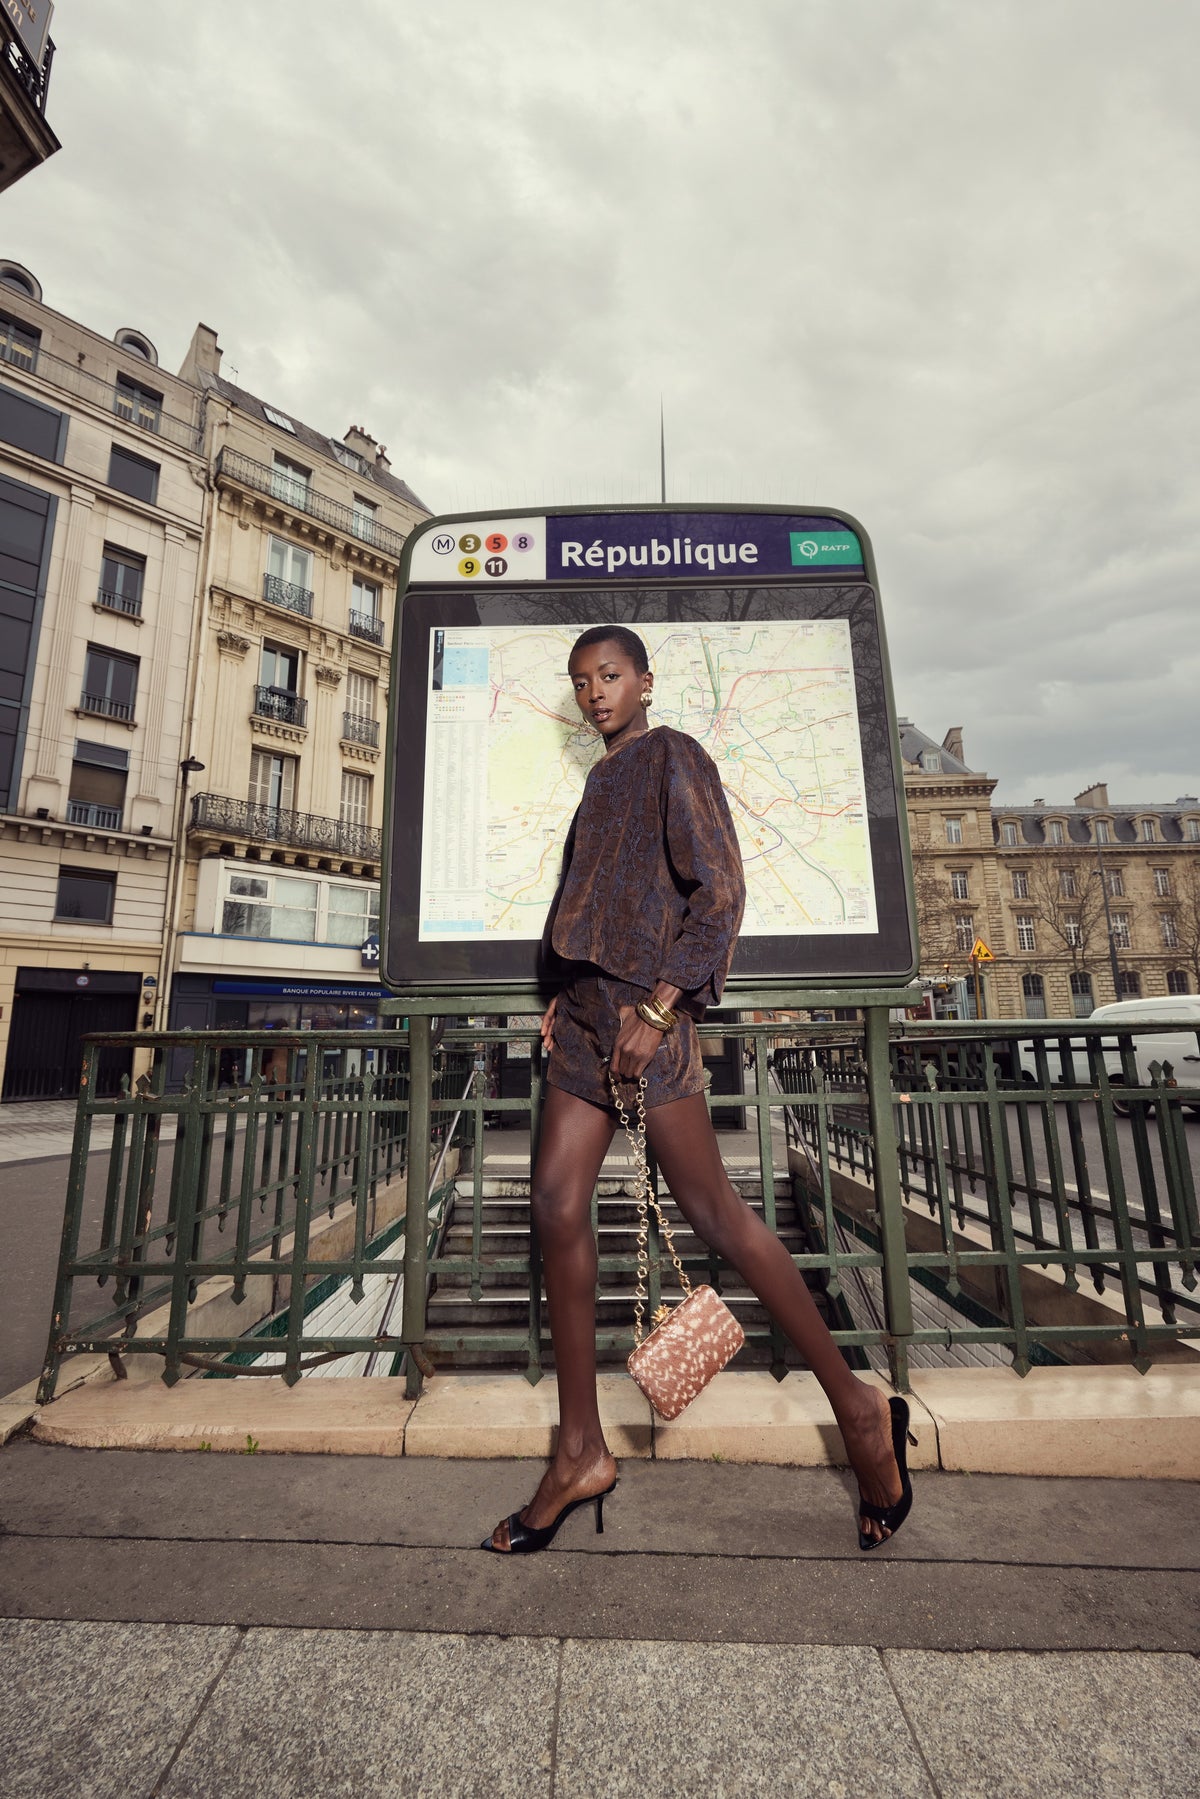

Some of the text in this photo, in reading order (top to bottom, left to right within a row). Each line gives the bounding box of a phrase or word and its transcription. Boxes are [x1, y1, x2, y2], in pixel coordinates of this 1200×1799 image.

[465, 537, 475, 550] 3
[492, 537, 501, 550] 5
[518, 536, 528, 549] 8
[561, 537, 759, 573] République
[464, 560, 503, 574] 9 11
